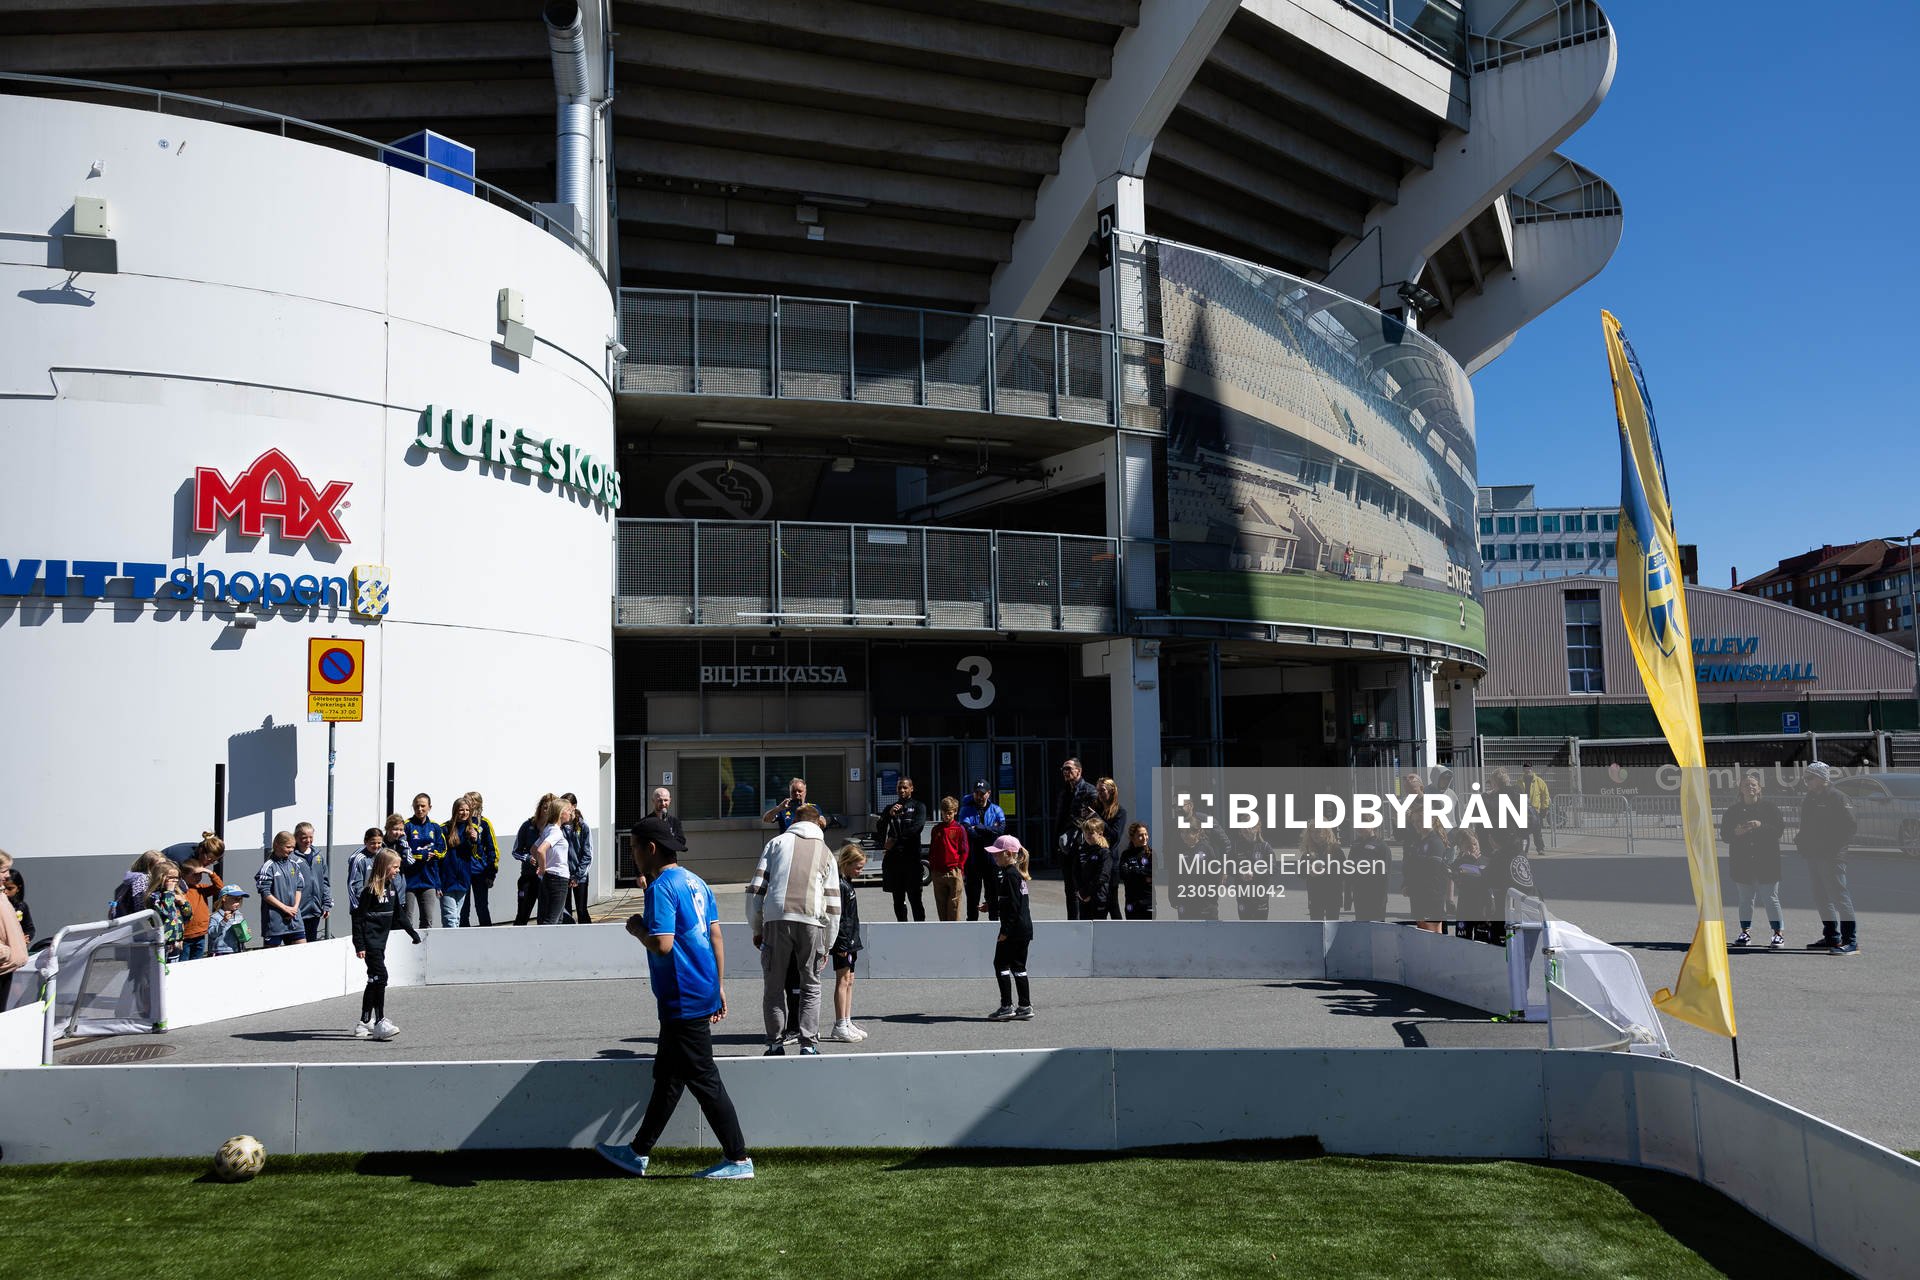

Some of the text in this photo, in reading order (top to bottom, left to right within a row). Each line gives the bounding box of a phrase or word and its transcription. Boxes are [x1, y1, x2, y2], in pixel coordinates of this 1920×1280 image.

[1101, 214, 1111, 238] D
[415, 404, 622, 510] JURESKOGS
[192, 447, 353, 544] MAX
[1446, 562, 1472, 596] ENTRÉ
[1459, 600, 1466, 626] 2
[699, 665, 848, 687] BILJETTKASSA
[956, 655, 996, 709] 3
[1787, 714, 1796, 726] P
[1655, 762, 1765, 791] Gmla
[1600, 786, 1639, 795] Got Event
